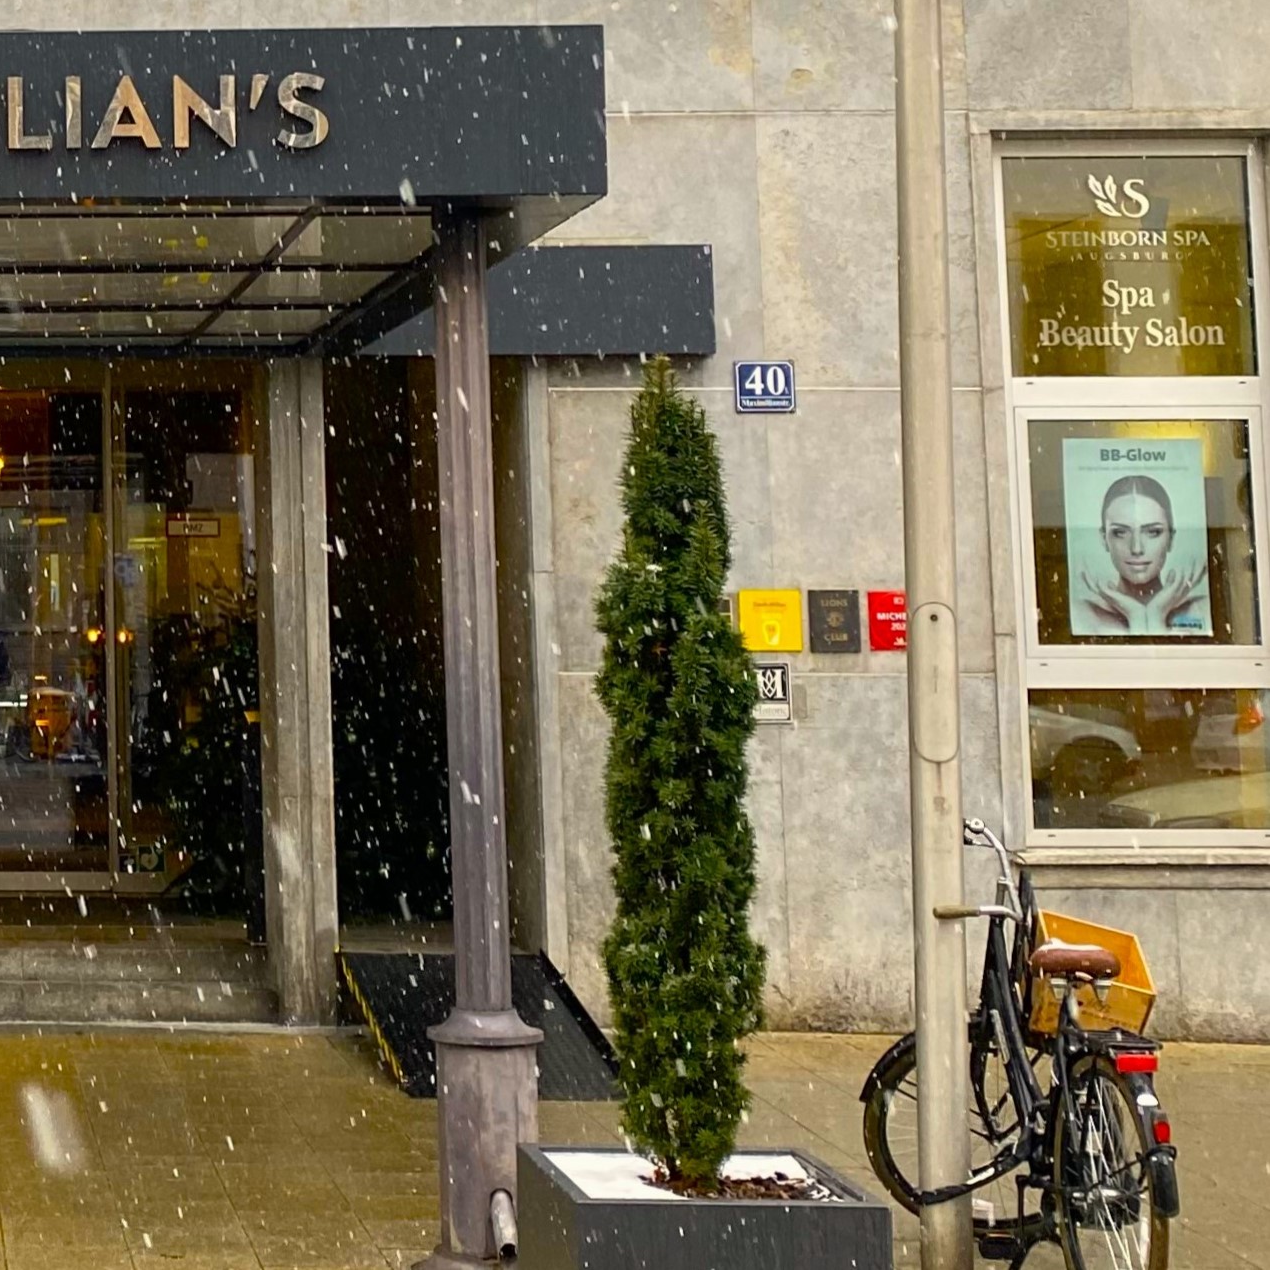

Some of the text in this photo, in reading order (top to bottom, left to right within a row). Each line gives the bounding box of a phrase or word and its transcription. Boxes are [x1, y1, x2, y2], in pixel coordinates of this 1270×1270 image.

[1045, 230, 1211, 248] STEINBORN SPA
[1101, 279, 1155, 315] Spa
[1040, 317, 1225, 354] Beauty Salon
[745, 365, 786, 396] 40
[1099, 448, 1167, 462] BB-Glow
[820, 598, 848, 607] LIONS
